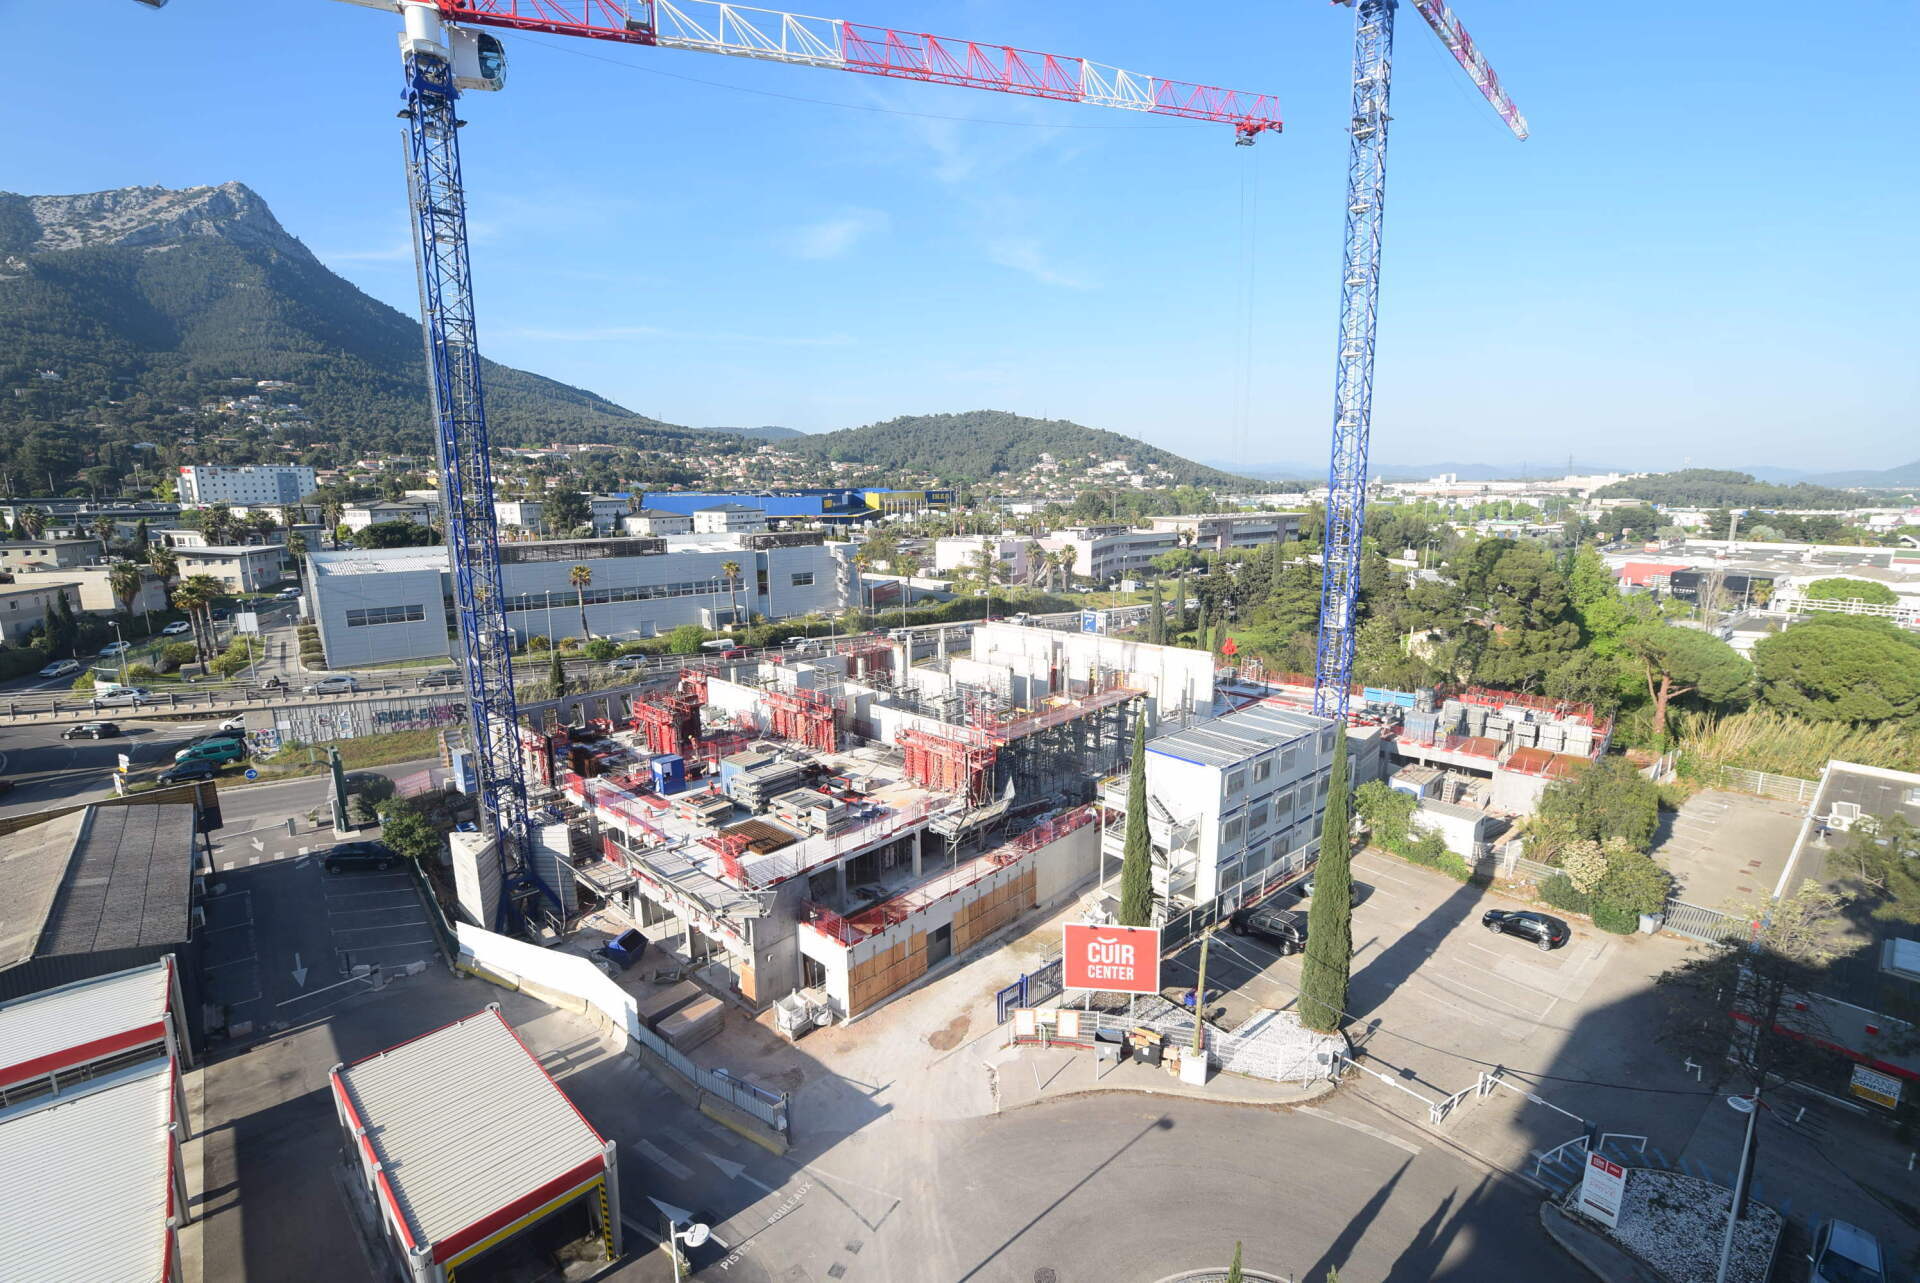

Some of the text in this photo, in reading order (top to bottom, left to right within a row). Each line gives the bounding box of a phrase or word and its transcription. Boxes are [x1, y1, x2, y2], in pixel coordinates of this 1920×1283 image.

[1087, 936, 1135, 966] CUIR
[1087, 964, 1135, 981] CENTER
[720, 1180, 814, 1270] PISTES ROULEAUX
